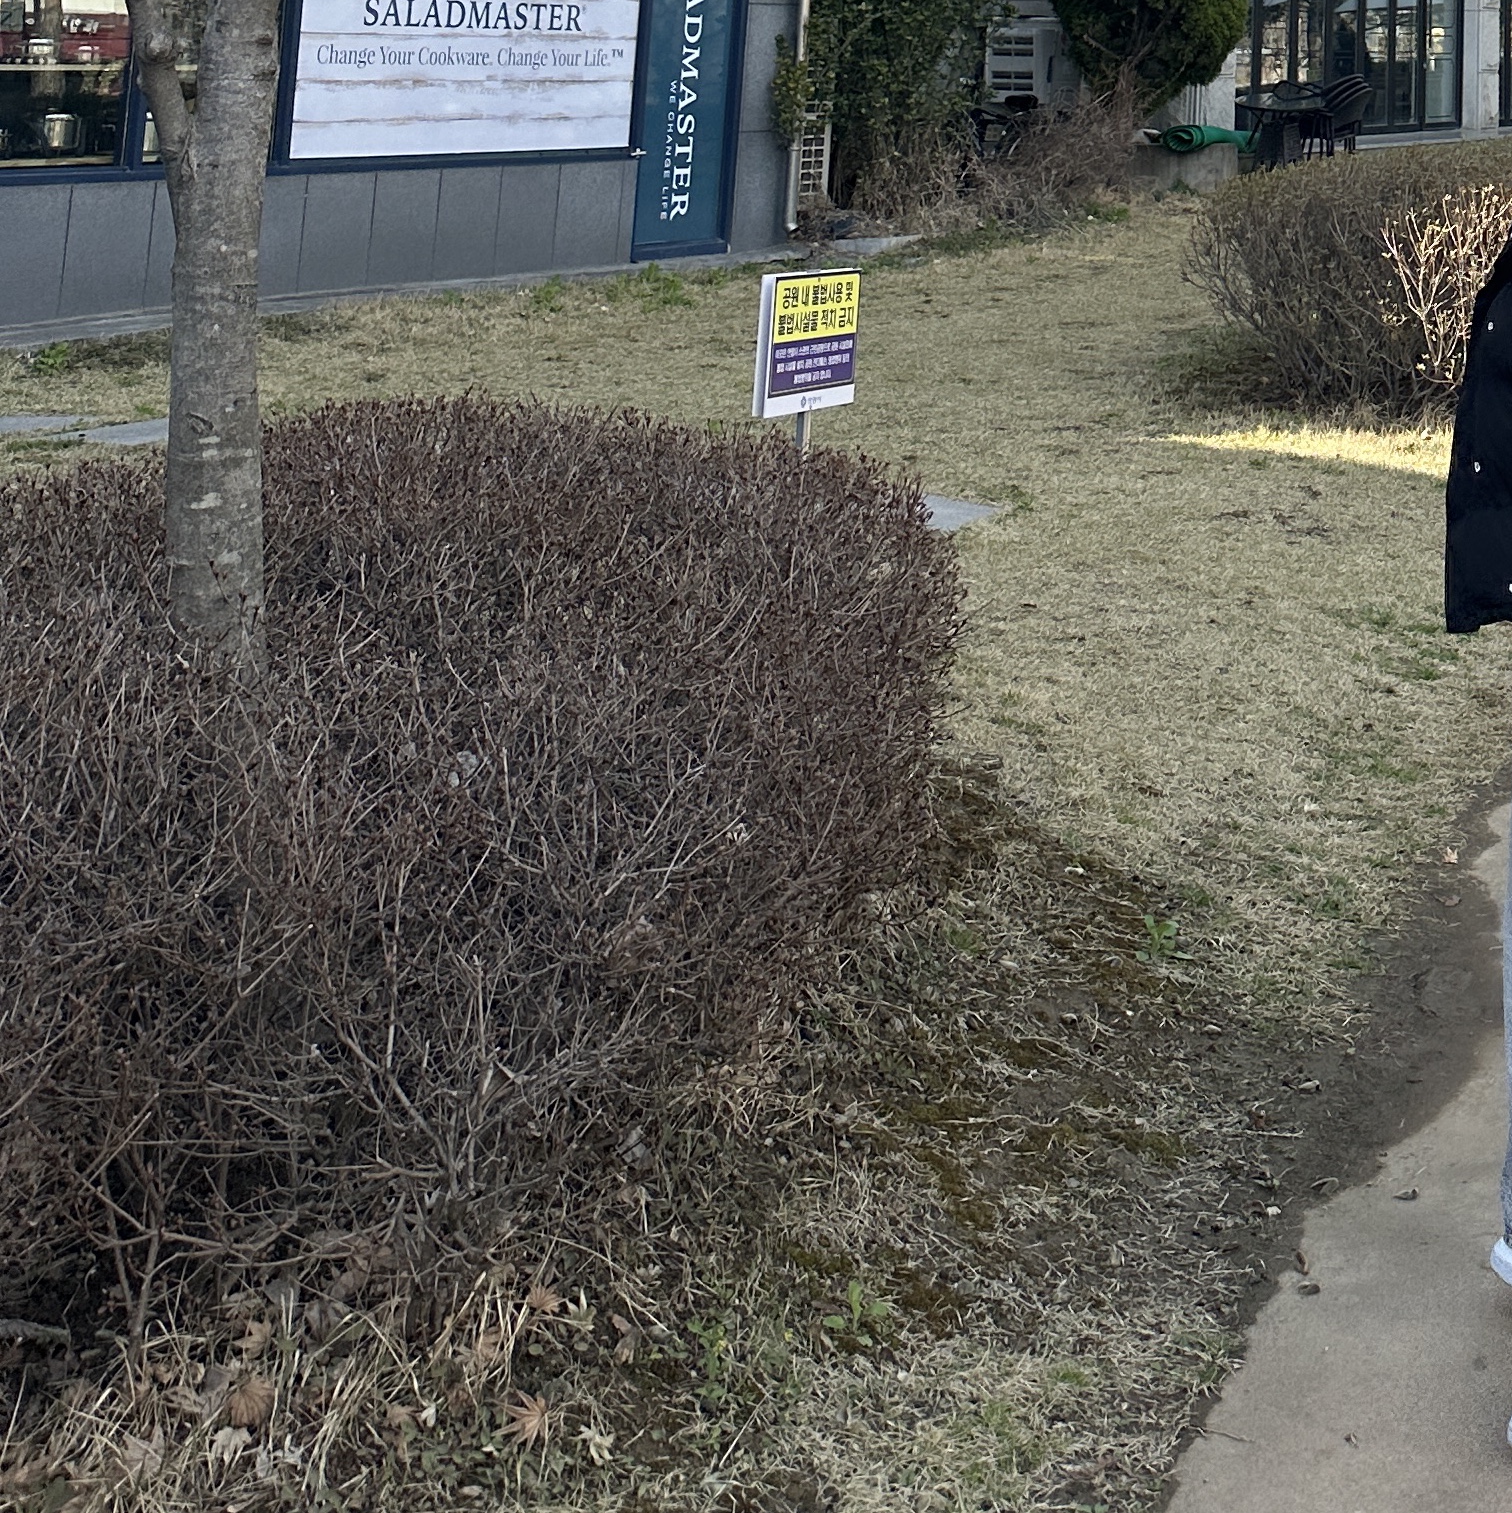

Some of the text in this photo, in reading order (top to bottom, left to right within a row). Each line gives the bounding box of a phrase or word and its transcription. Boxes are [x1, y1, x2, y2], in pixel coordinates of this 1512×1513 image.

[316, 43, 376, 68] Change
[380, 45, 416, 65] Your
[418, 45, 493, 66] Cookware.
[497, 47, 548, 70] Change
[551, 48, 582, 67] Your
[660, 80, 678, 220] WE CHANGE LIFE
[782, 286, 800, 310] 공원
[801, 285, 810, 307] 내
[811, 282, 844, 306] 불법사용
[777, 306, 855, 336] 불법시설물 적치 금지
